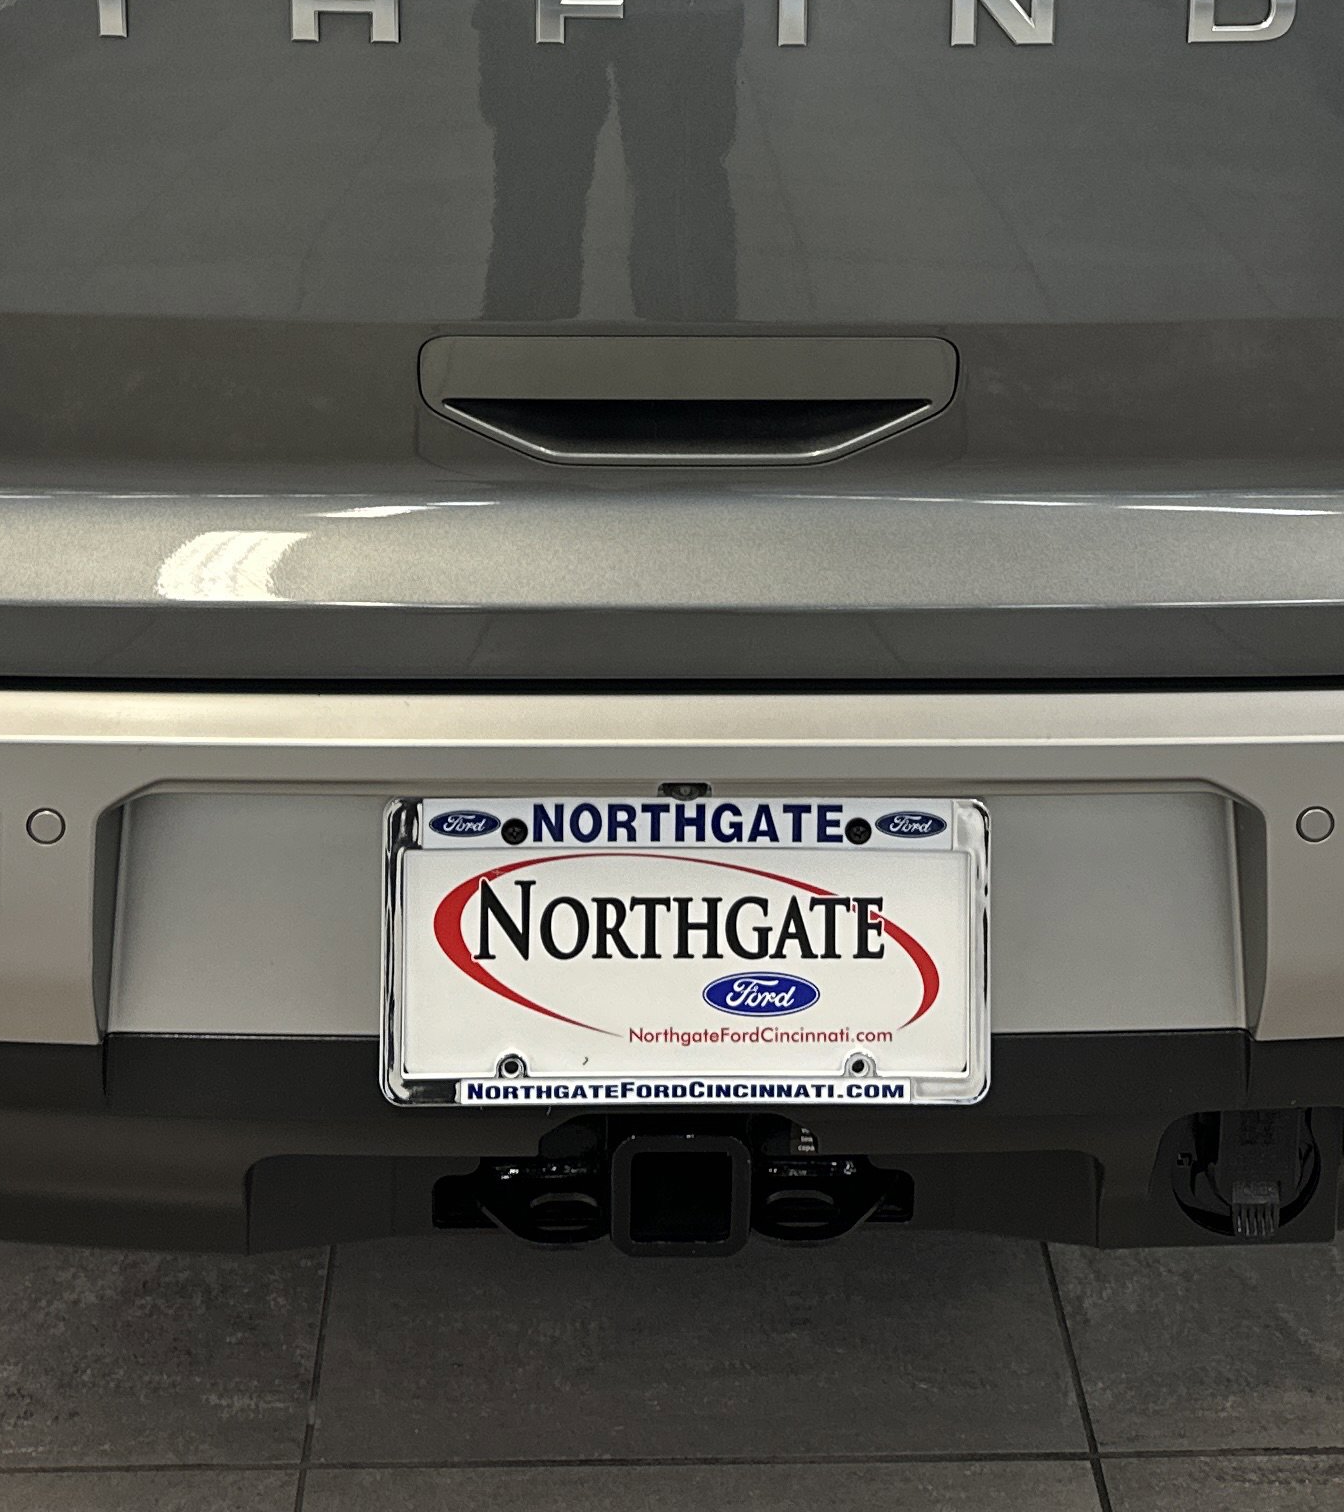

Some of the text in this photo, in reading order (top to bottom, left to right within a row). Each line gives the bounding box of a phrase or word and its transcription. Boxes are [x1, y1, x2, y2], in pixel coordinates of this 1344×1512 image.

[441, 803, 932, 844] Ford NORTHGATE Ford
[474, 879, 887, 962] NORTHGATE
[725, 978, 796, 1008] Ford
[628, 1027, 894, 1046] NorthgateFordCincinnati.com
